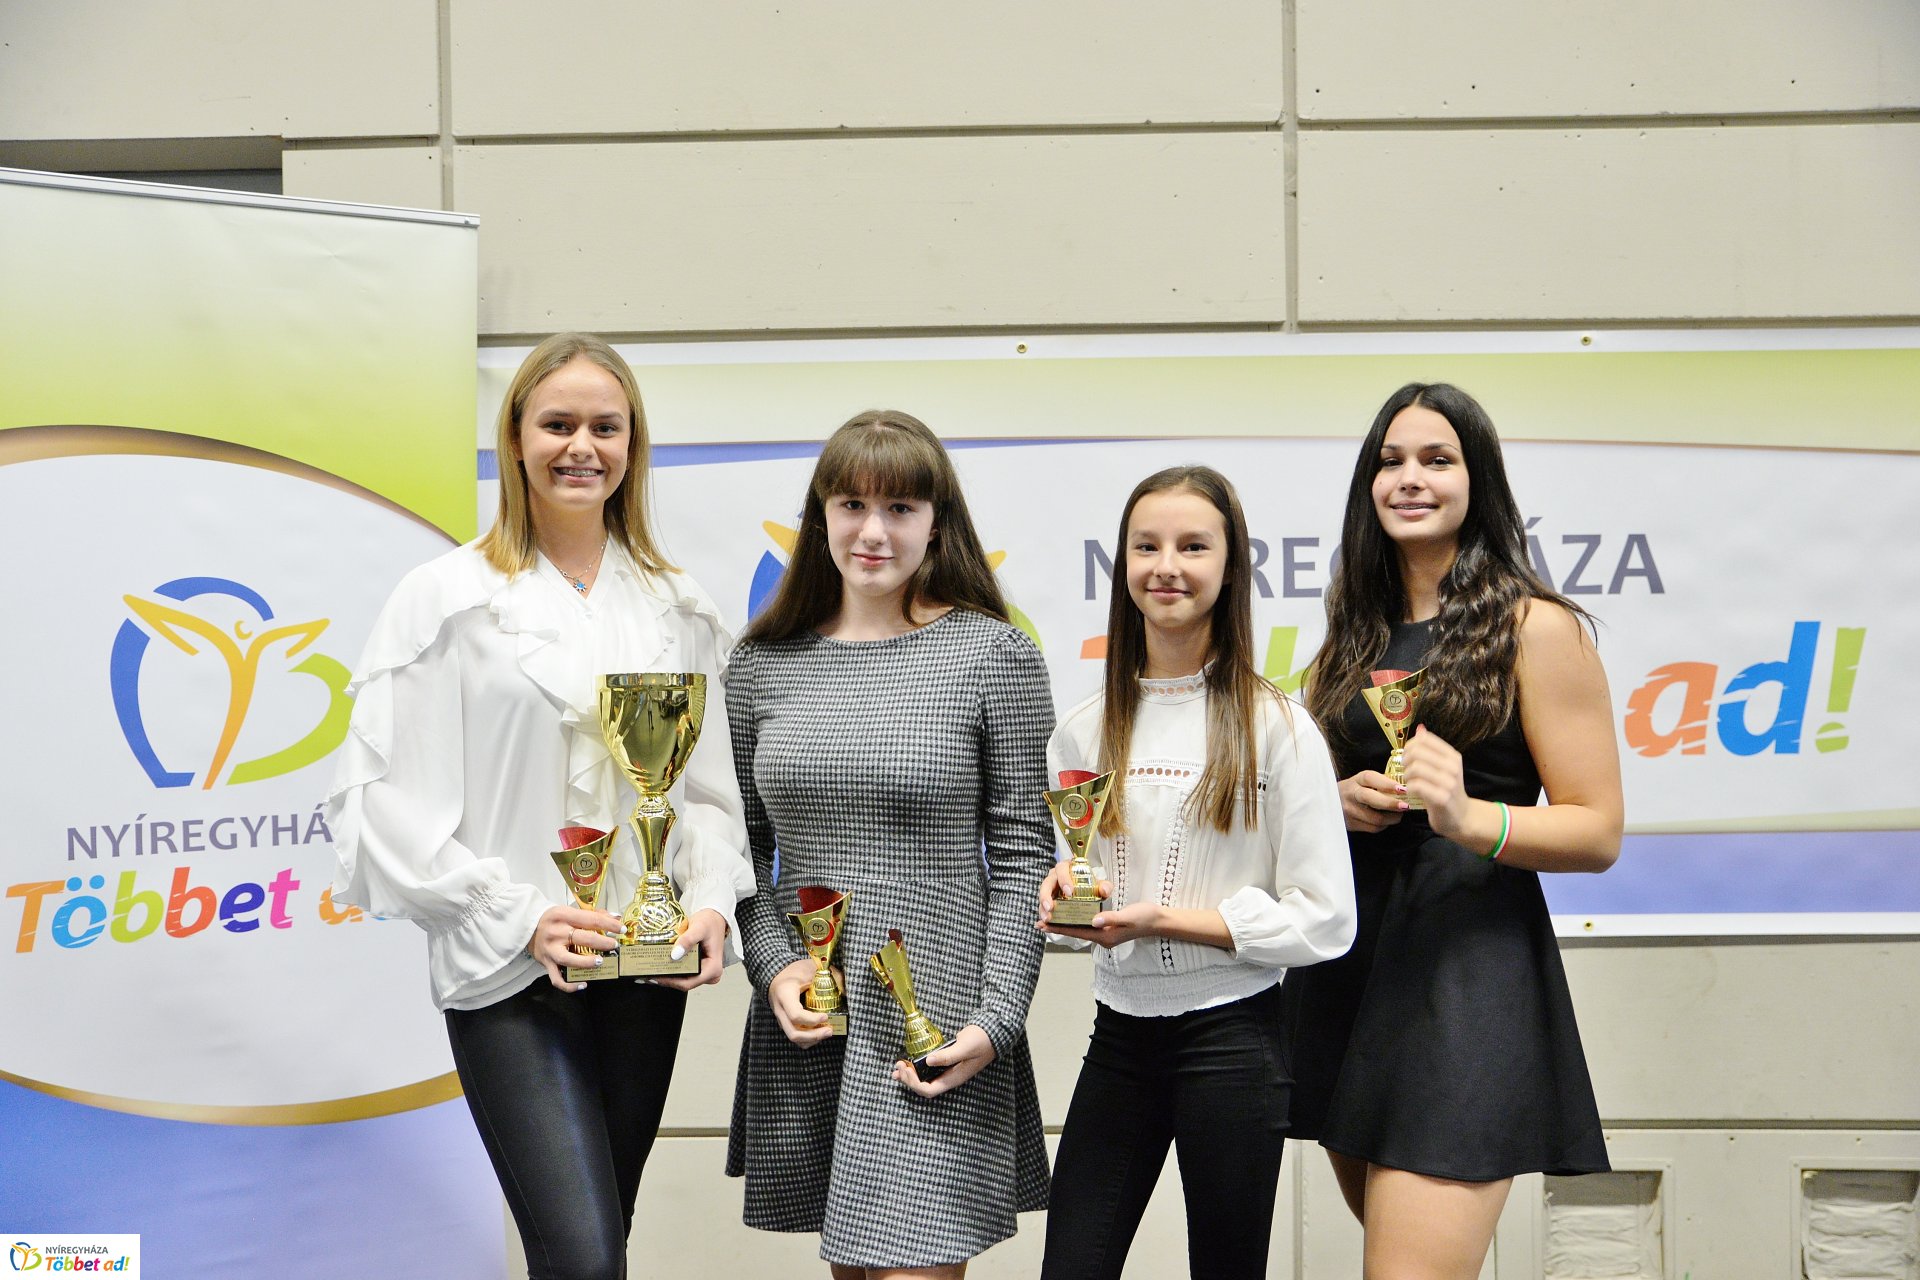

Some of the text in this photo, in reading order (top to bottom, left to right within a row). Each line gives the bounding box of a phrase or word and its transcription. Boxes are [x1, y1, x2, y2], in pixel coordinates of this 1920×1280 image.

[1084, 516, 1666, 600] NREÁZA
[1624, 621, 1867, 757] ad!
[67, 803, 333, 861] NYÍREGYHÁ
[5, 866, 300, 953] Többet
